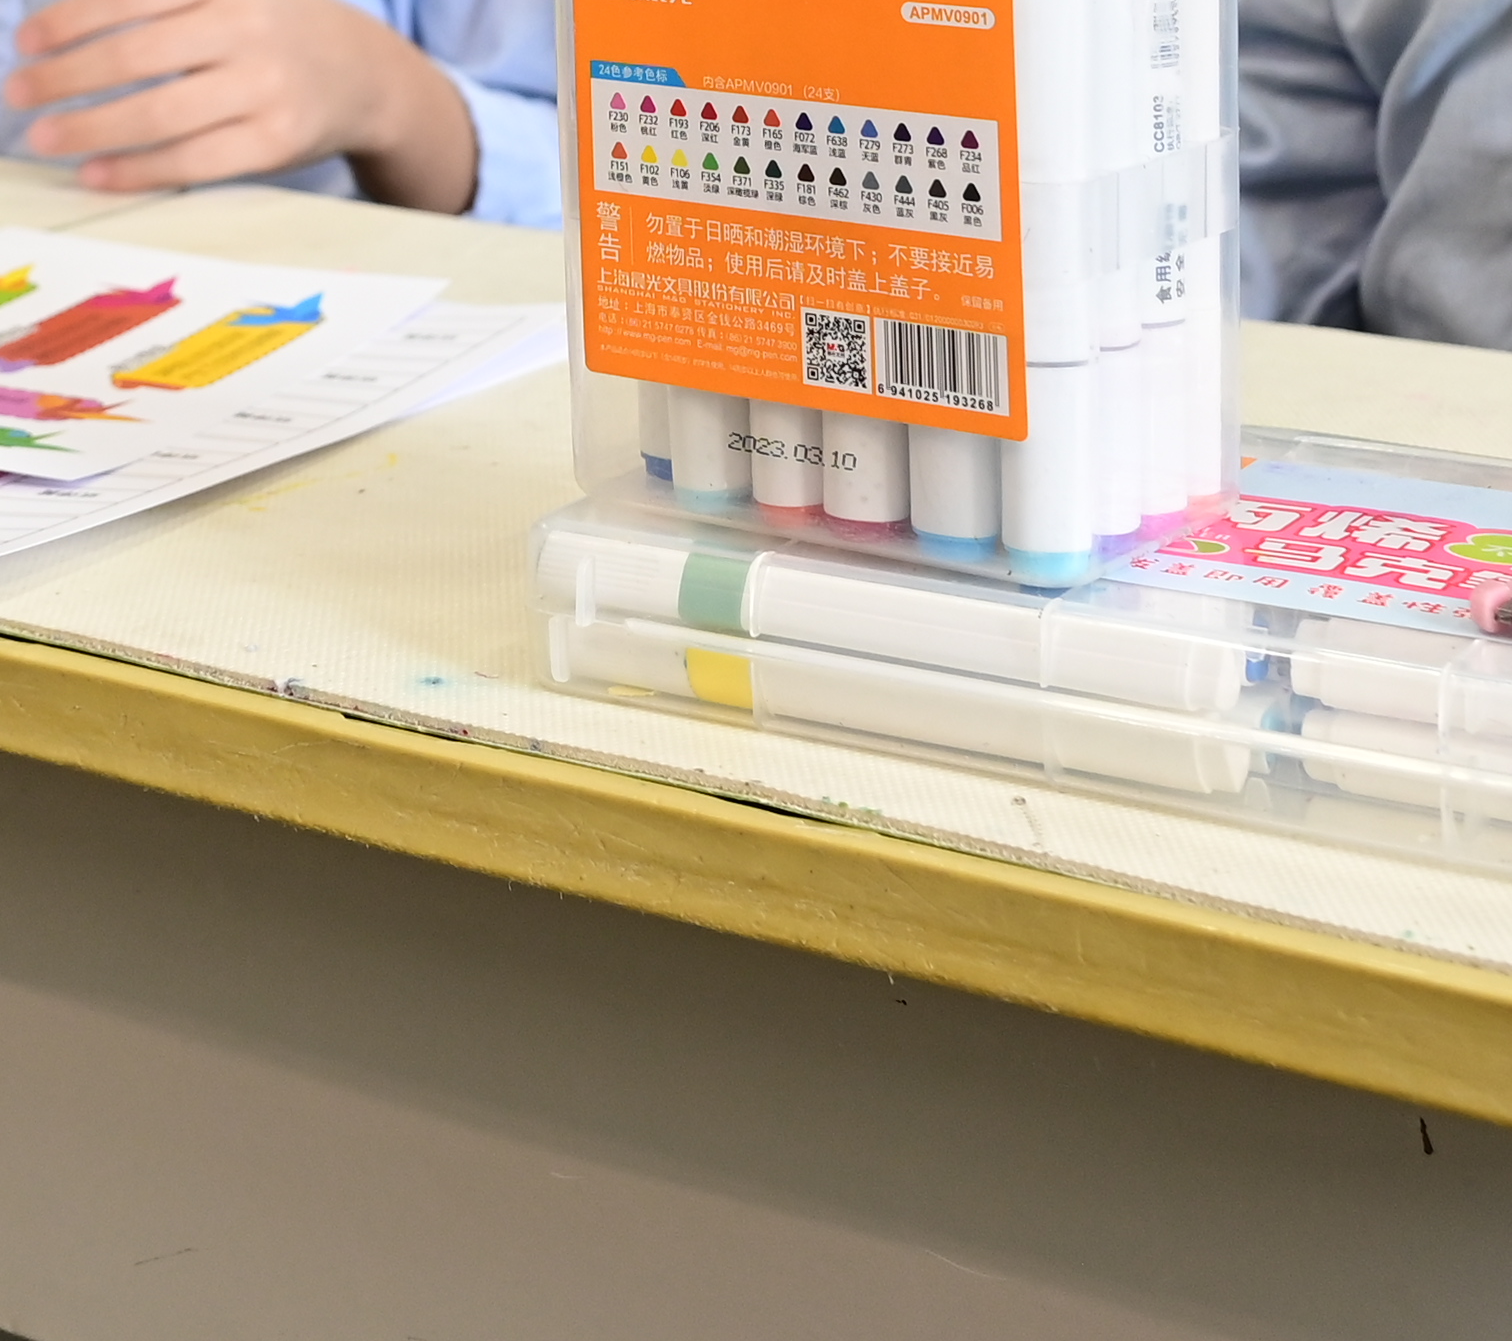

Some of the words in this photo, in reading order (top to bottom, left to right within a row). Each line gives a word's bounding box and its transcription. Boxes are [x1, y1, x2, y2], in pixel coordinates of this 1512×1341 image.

[909, 5, 988, 25] APMV0901
[598, 64, 668, 83] 24色参考色标
[609, 111, 628, 122] F230
[639, 114, 658, 125] F232
[669, 118, 689, 129] F193
[700, 121, 720, 132] F206
[731, 125, 751, 136] F173
[763, 128, 782, 139] F165
[794, 131, 815, 143] F072
[826, 135, 847, 147] F638
[859, 139, 880, 151] F279
[892, 143, 913, 155] F273
[926, 146, 947, 158] F268
[960, 150, 982, 162] F234
[611, 160, 629, 171] F151
[640, 164, 659, 175] F102
[670, 168, 690, 179] F106
[701, 171, 721, 183] F354
[733, 175, 752, 187] F371
[764, 179, 784, 190] F335
[797, 183, 816, 195] F181
[828, 187, 849, 199] F462
[861, 191, 882, 203] F430
[894, 195, 915, 207] F444
[928, 198, 949, 211] F405
[961, 202, 983, 215] F006
[597, 268, 795, 311] 上海晨光文具股份有限公司
[597, 285, 656, 299] SHANGHAI
[694, 299, 765, 314] STATIONERY
